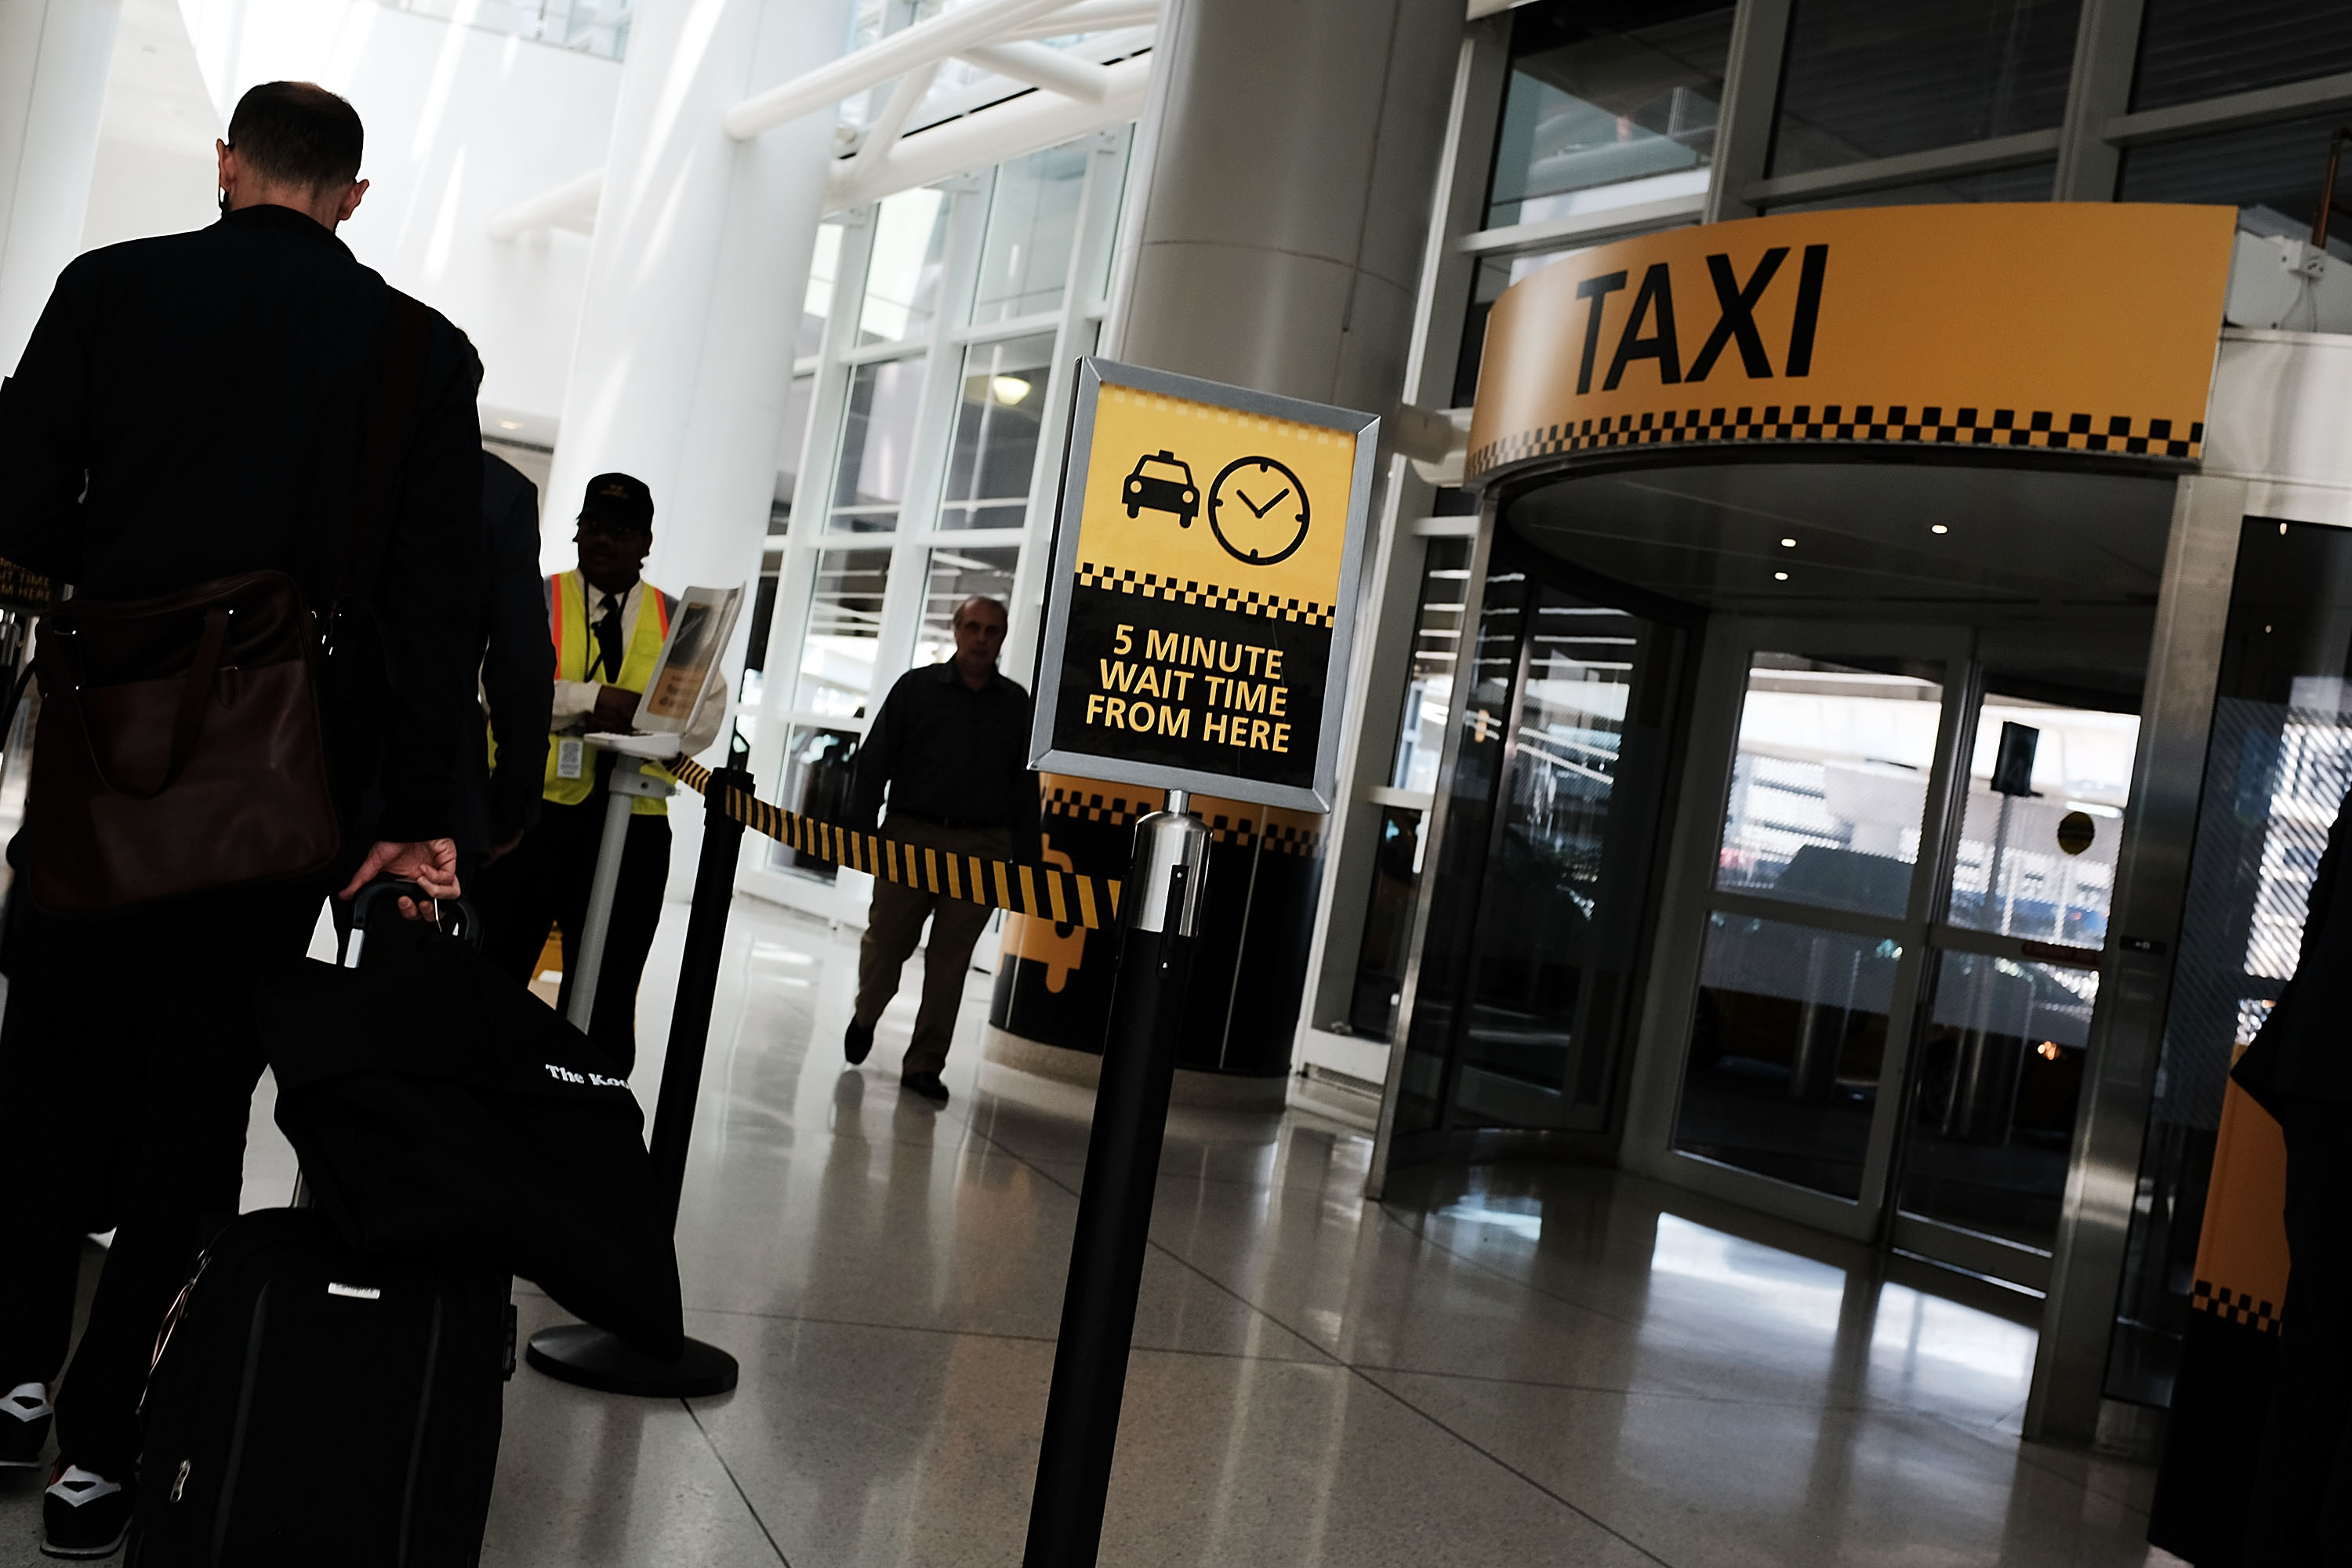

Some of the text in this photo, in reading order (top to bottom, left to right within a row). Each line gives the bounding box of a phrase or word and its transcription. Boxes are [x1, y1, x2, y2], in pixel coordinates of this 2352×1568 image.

[1576, 244, 1829, 395] TAXI
[1113, 623, 1284, 681] 5 MINUTE
[1099, 658, 1289, 717] WAIT TIME
[1086, 694, 1292, 753] FROM HERE
[545, 1063, 585, 1084] The
